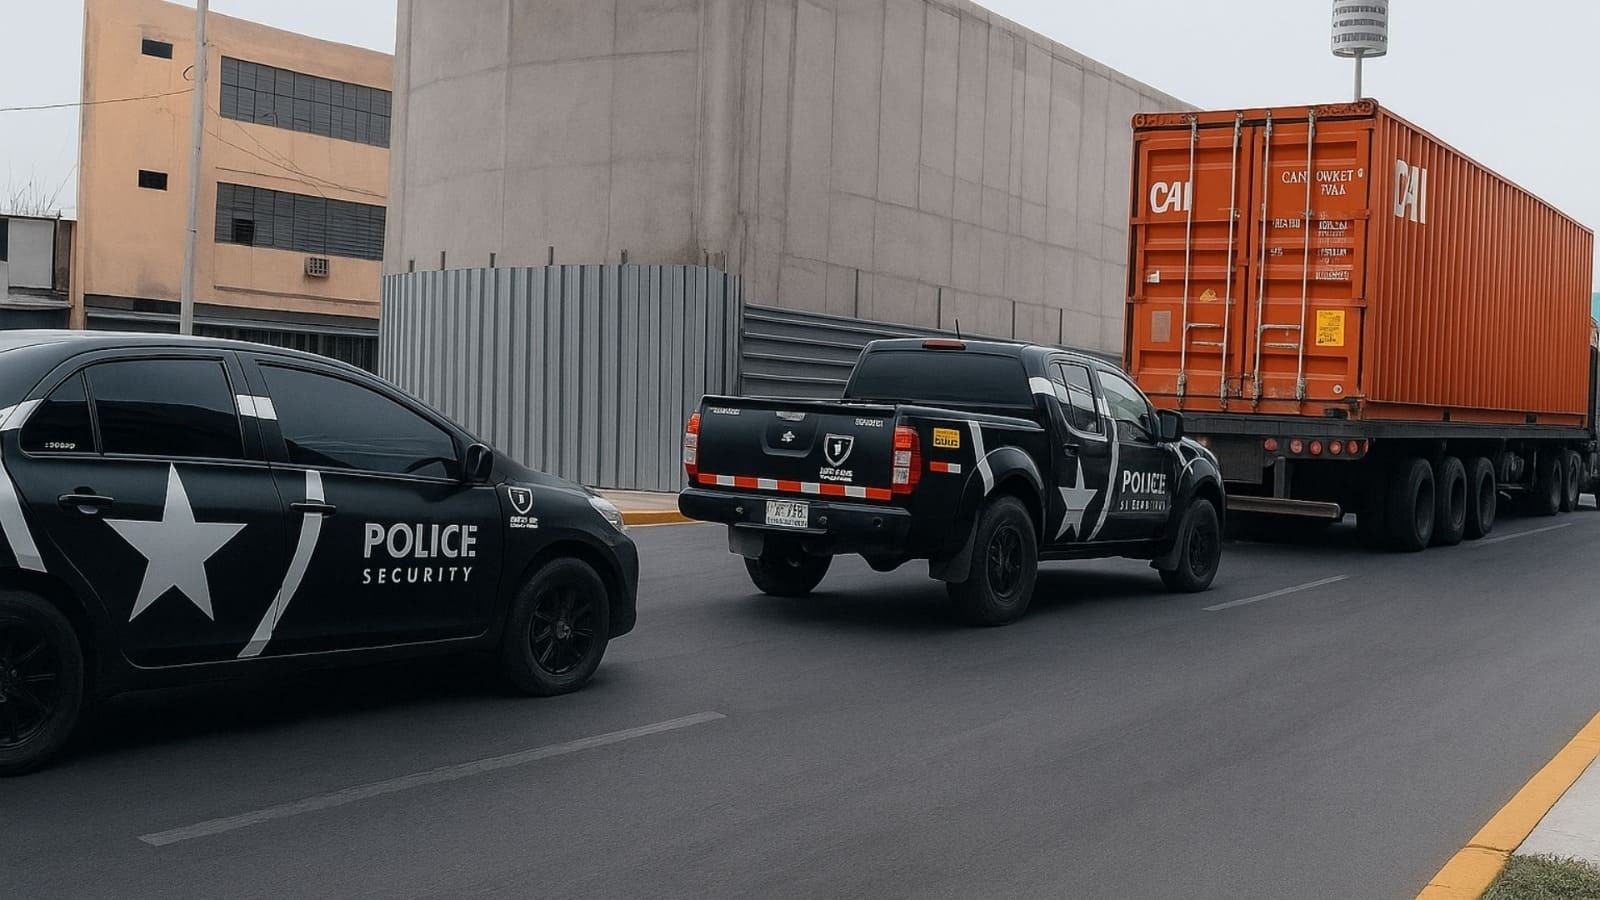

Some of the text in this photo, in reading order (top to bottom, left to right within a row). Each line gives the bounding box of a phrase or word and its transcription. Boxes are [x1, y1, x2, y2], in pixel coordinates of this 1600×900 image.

[1150, 181, 1192, 213] CAI
[363, 522, 478, 559] POLICE
[361, 566, 473, 585] SECURITY
